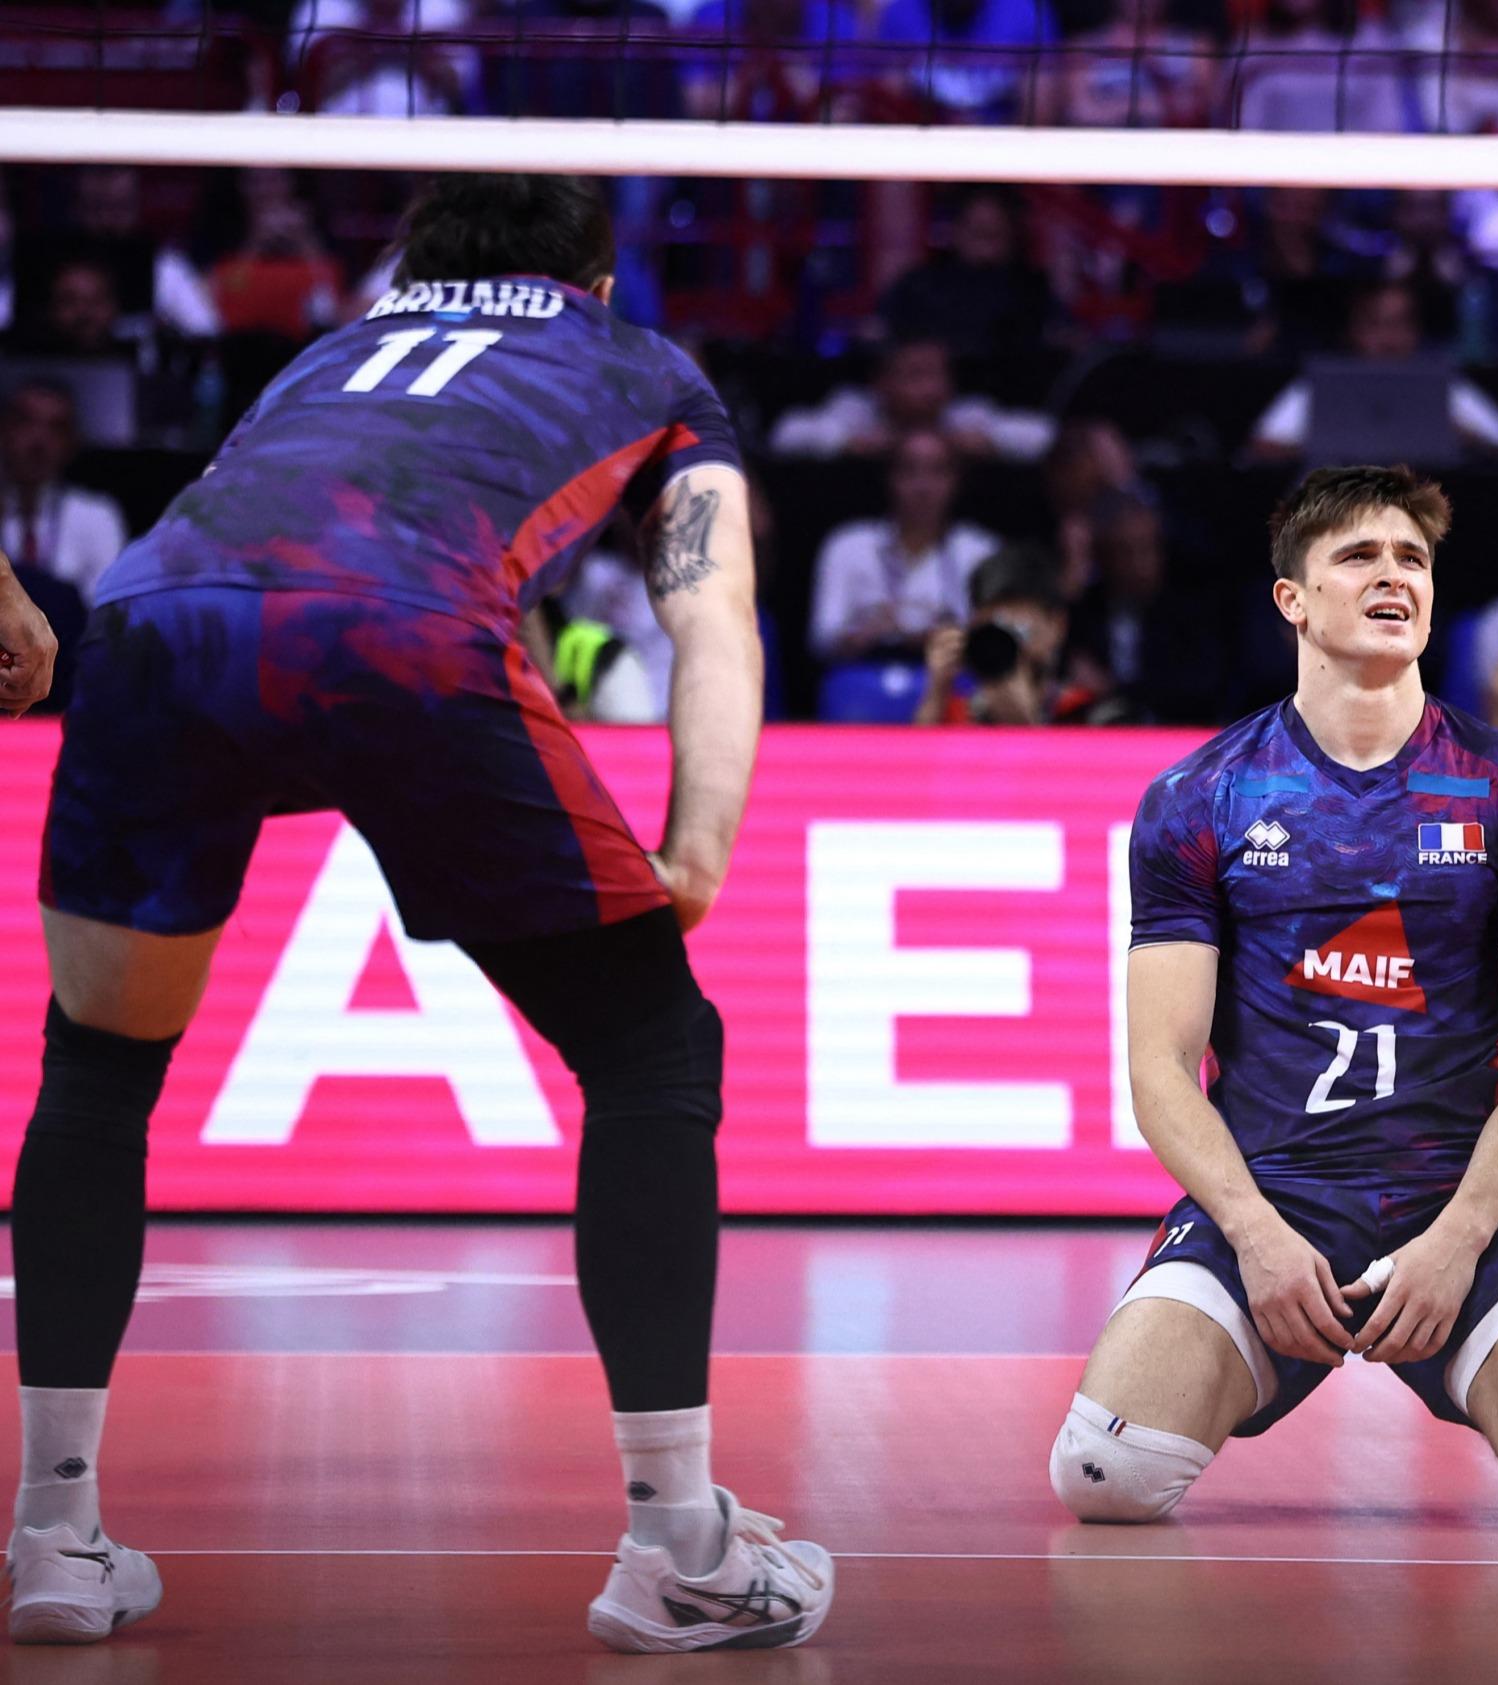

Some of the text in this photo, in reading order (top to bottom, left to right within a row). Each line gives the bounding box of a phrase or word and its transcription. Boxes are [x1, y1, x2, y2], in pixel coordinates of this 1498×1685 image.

[342, 327, 503, 397] 11
[1418, 852, 1488, 864] FRANCE
[1303, 949, 1415, 989] MAIF
[1305, 1020, 1397, 1114] 21
